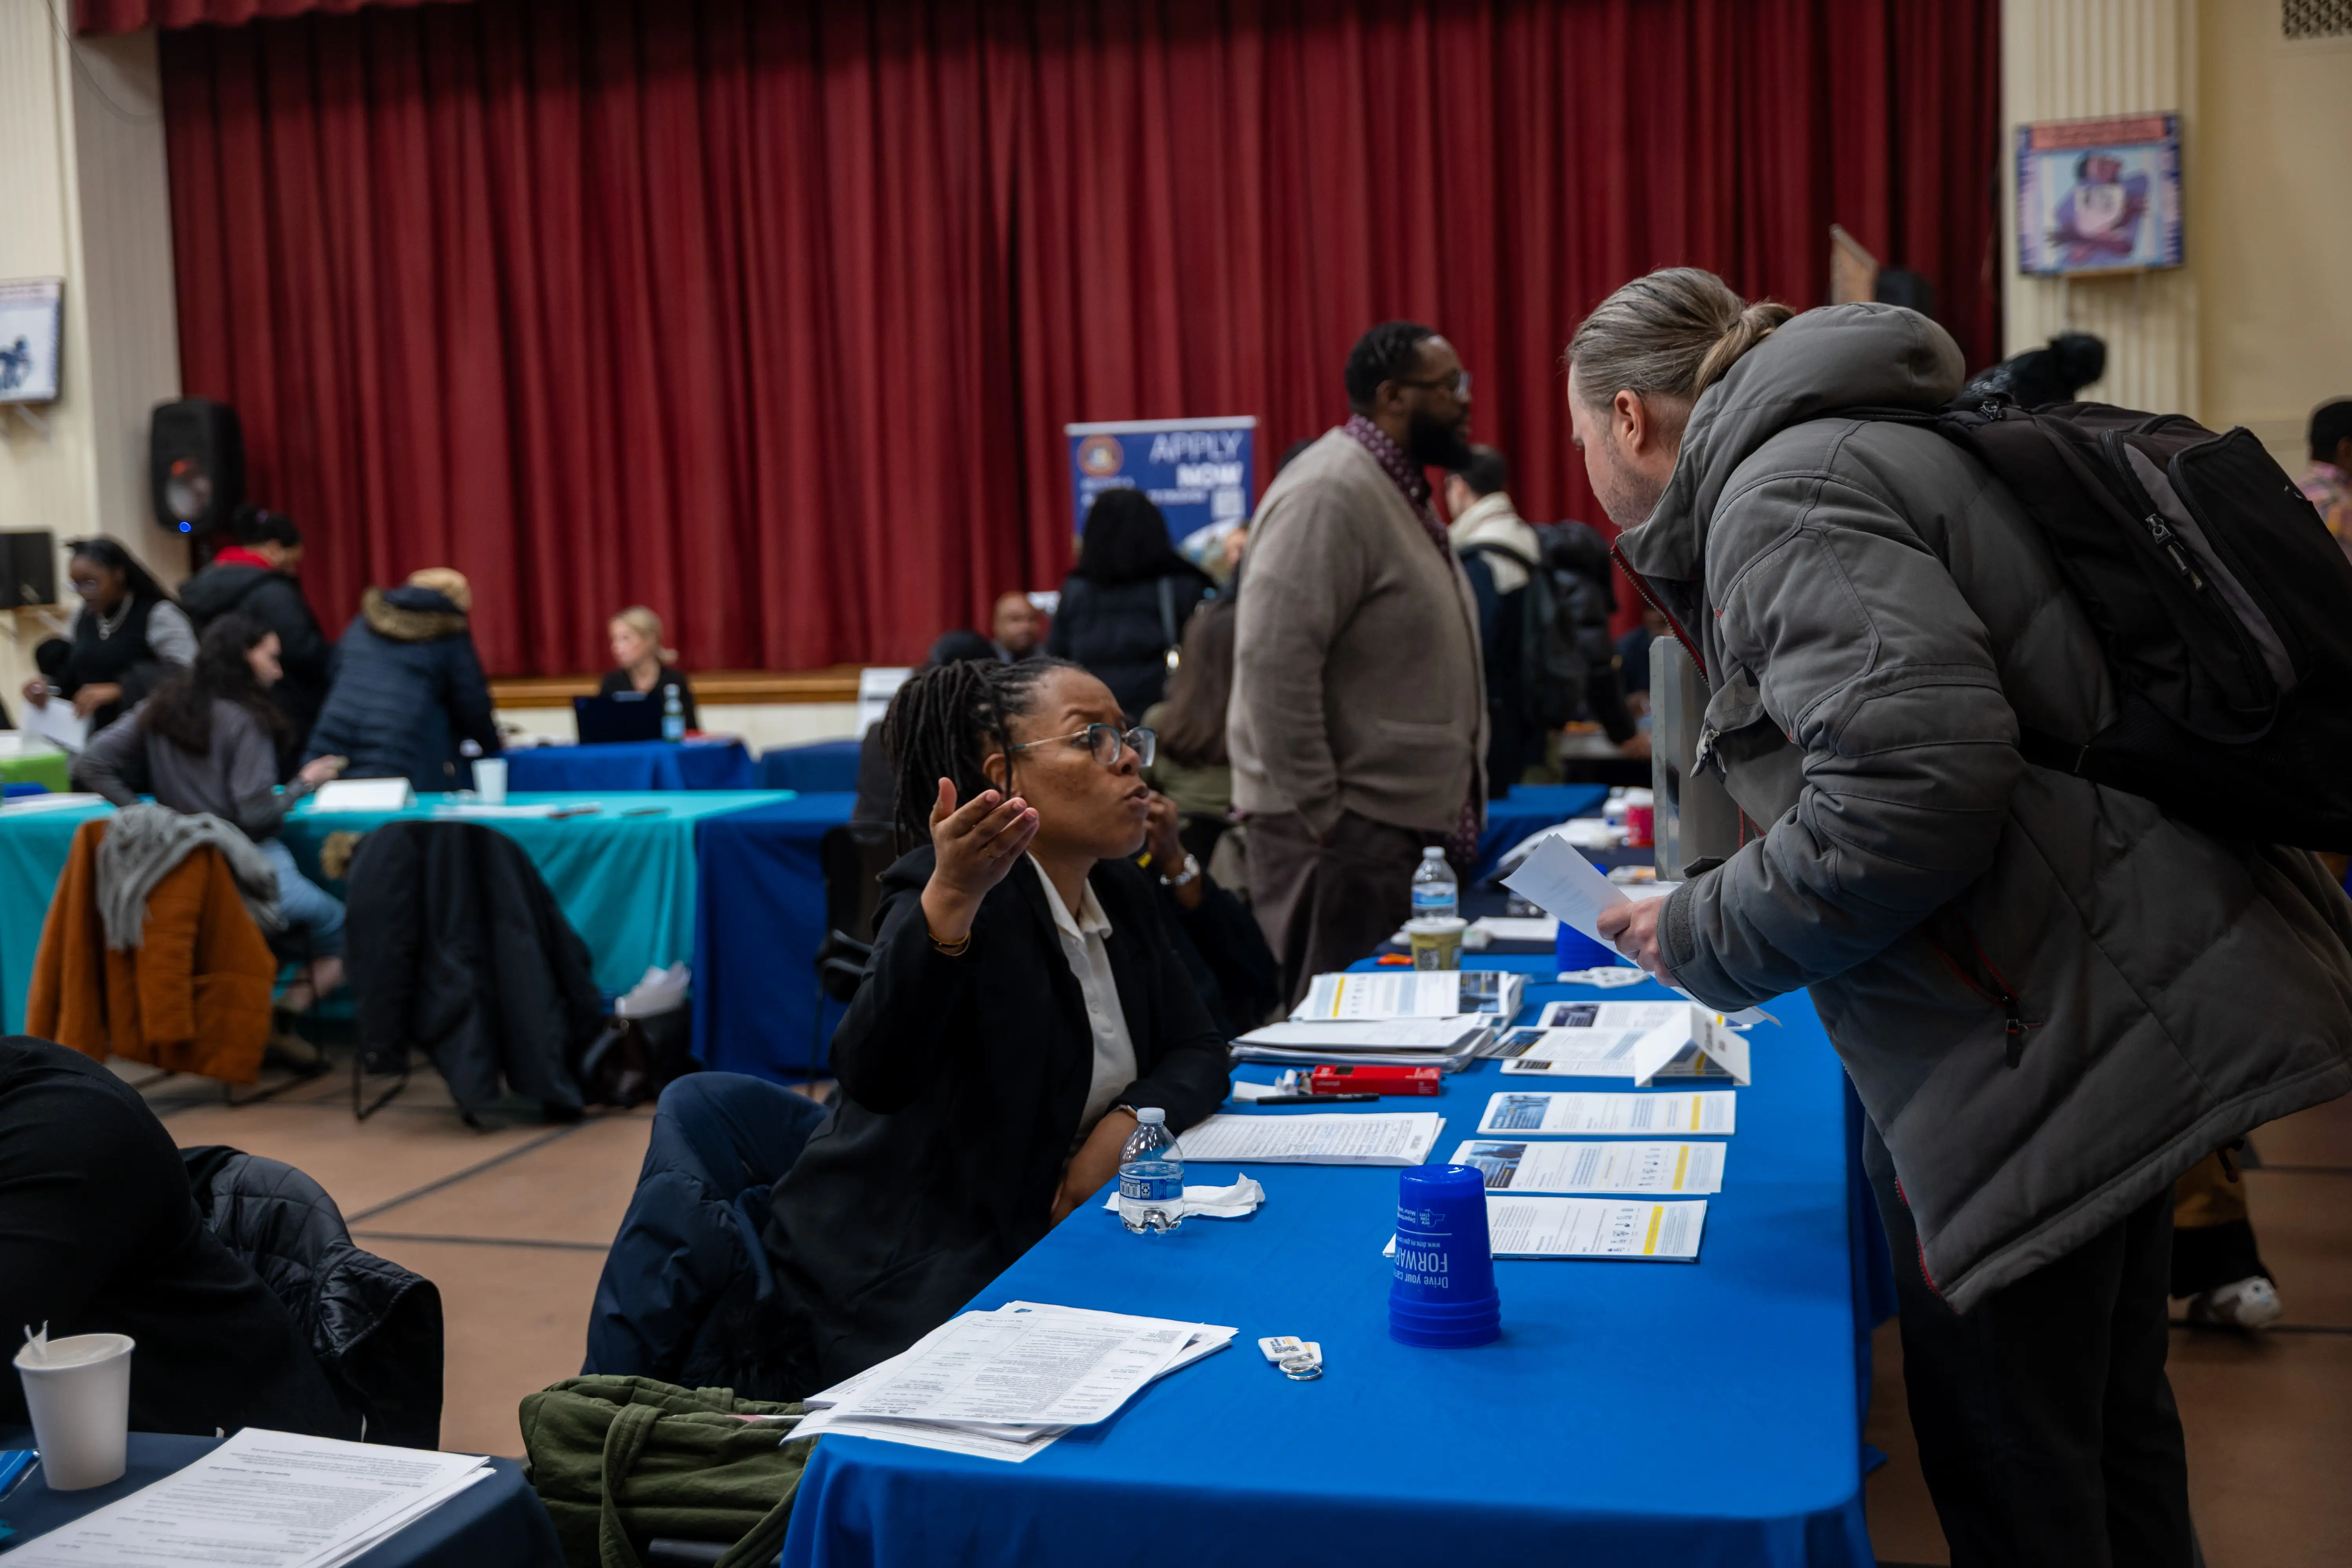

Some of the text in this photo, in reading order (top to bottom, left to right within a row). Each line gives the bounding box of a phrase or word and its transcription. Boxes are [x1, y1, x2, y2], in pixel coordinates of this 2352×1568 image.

[1149, 431, 1243, 465] APPLY
[1177, 462, 1244, 488] NOW
[1405, 1274, 1421, 1284] your
[1424, 1276, 1448, 1288] Drive
